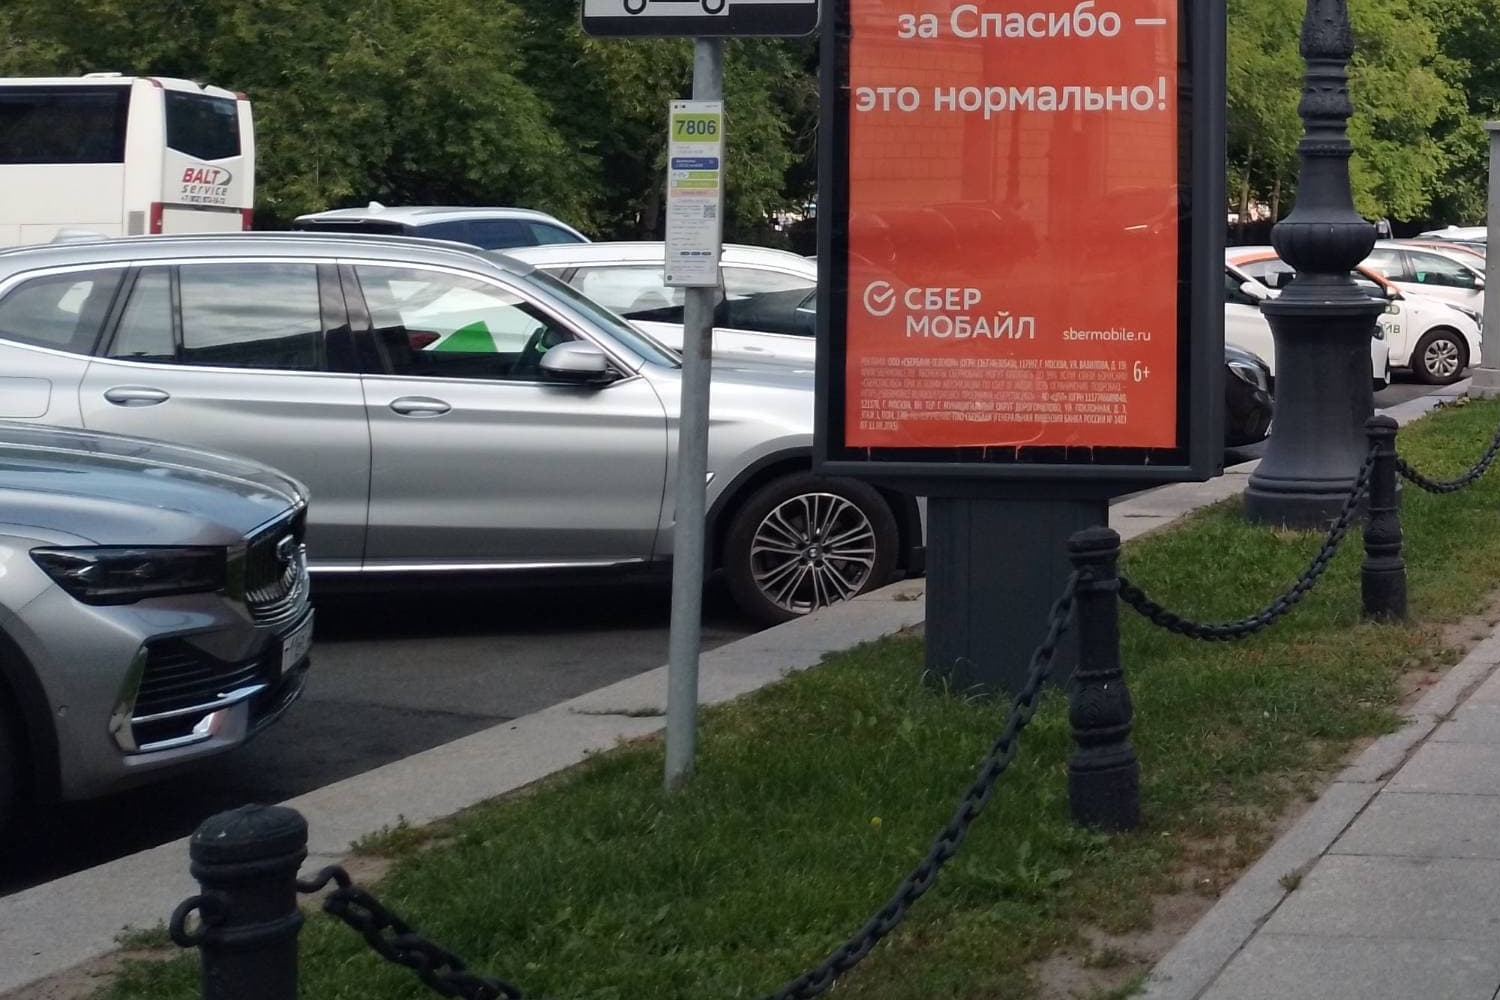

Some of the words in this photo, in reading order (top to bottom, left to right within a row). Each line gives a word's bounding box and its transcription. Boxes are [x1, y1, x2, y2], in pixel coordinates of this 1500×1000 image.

[897, 13, 939, 38] за
[949, 0, 1122, 38] Спасибо
[855, 86, 920, 111] это
[934, 76, 1167, 120] нормально!
[675, 119, 716, 135] 7806
[182, 167, 221, 185] BALT
[903, 287, 982, 311] СБЕР
[906, 310, 1036, 340] МОБАЙЛ
[1063, 327, 1151, 342] sbermobile.ru
[1133, 360, 1150, 383] 6+
